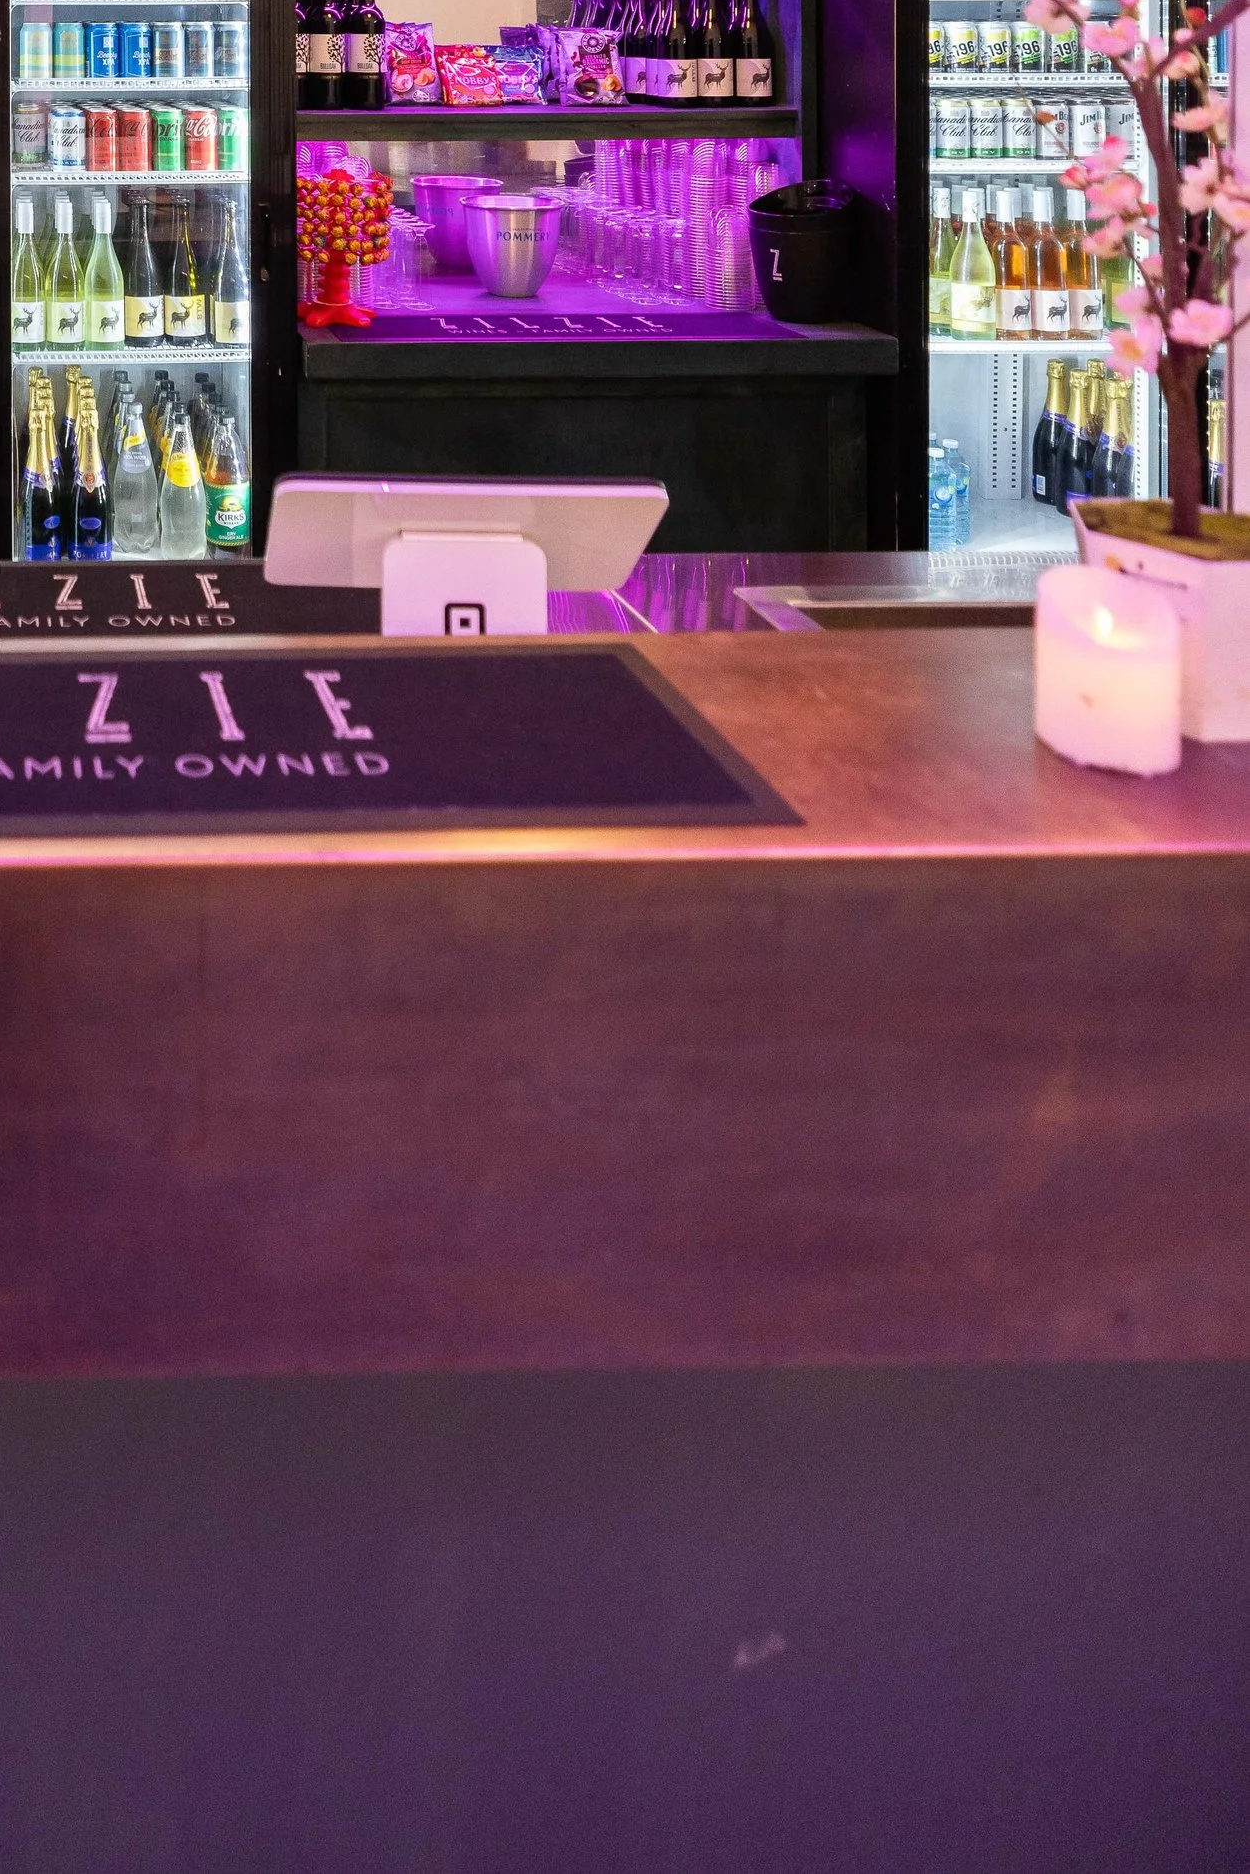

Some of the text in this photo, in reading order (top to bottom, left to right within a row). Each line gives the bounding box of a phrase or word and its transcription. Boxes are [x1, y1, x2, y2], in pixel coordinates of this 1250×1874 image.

[455, 76, 497, 85] NOBBY'S
[1080, 114, 1097, 126] JIM
[496, 230, 550, 242] POMMER
[196, 297, 204, 321] BTW
[217, 512, 245, 522] KIRKS
[107, 614, 236, 628] OWNED
[174, 751, 390, 779] OWNED
